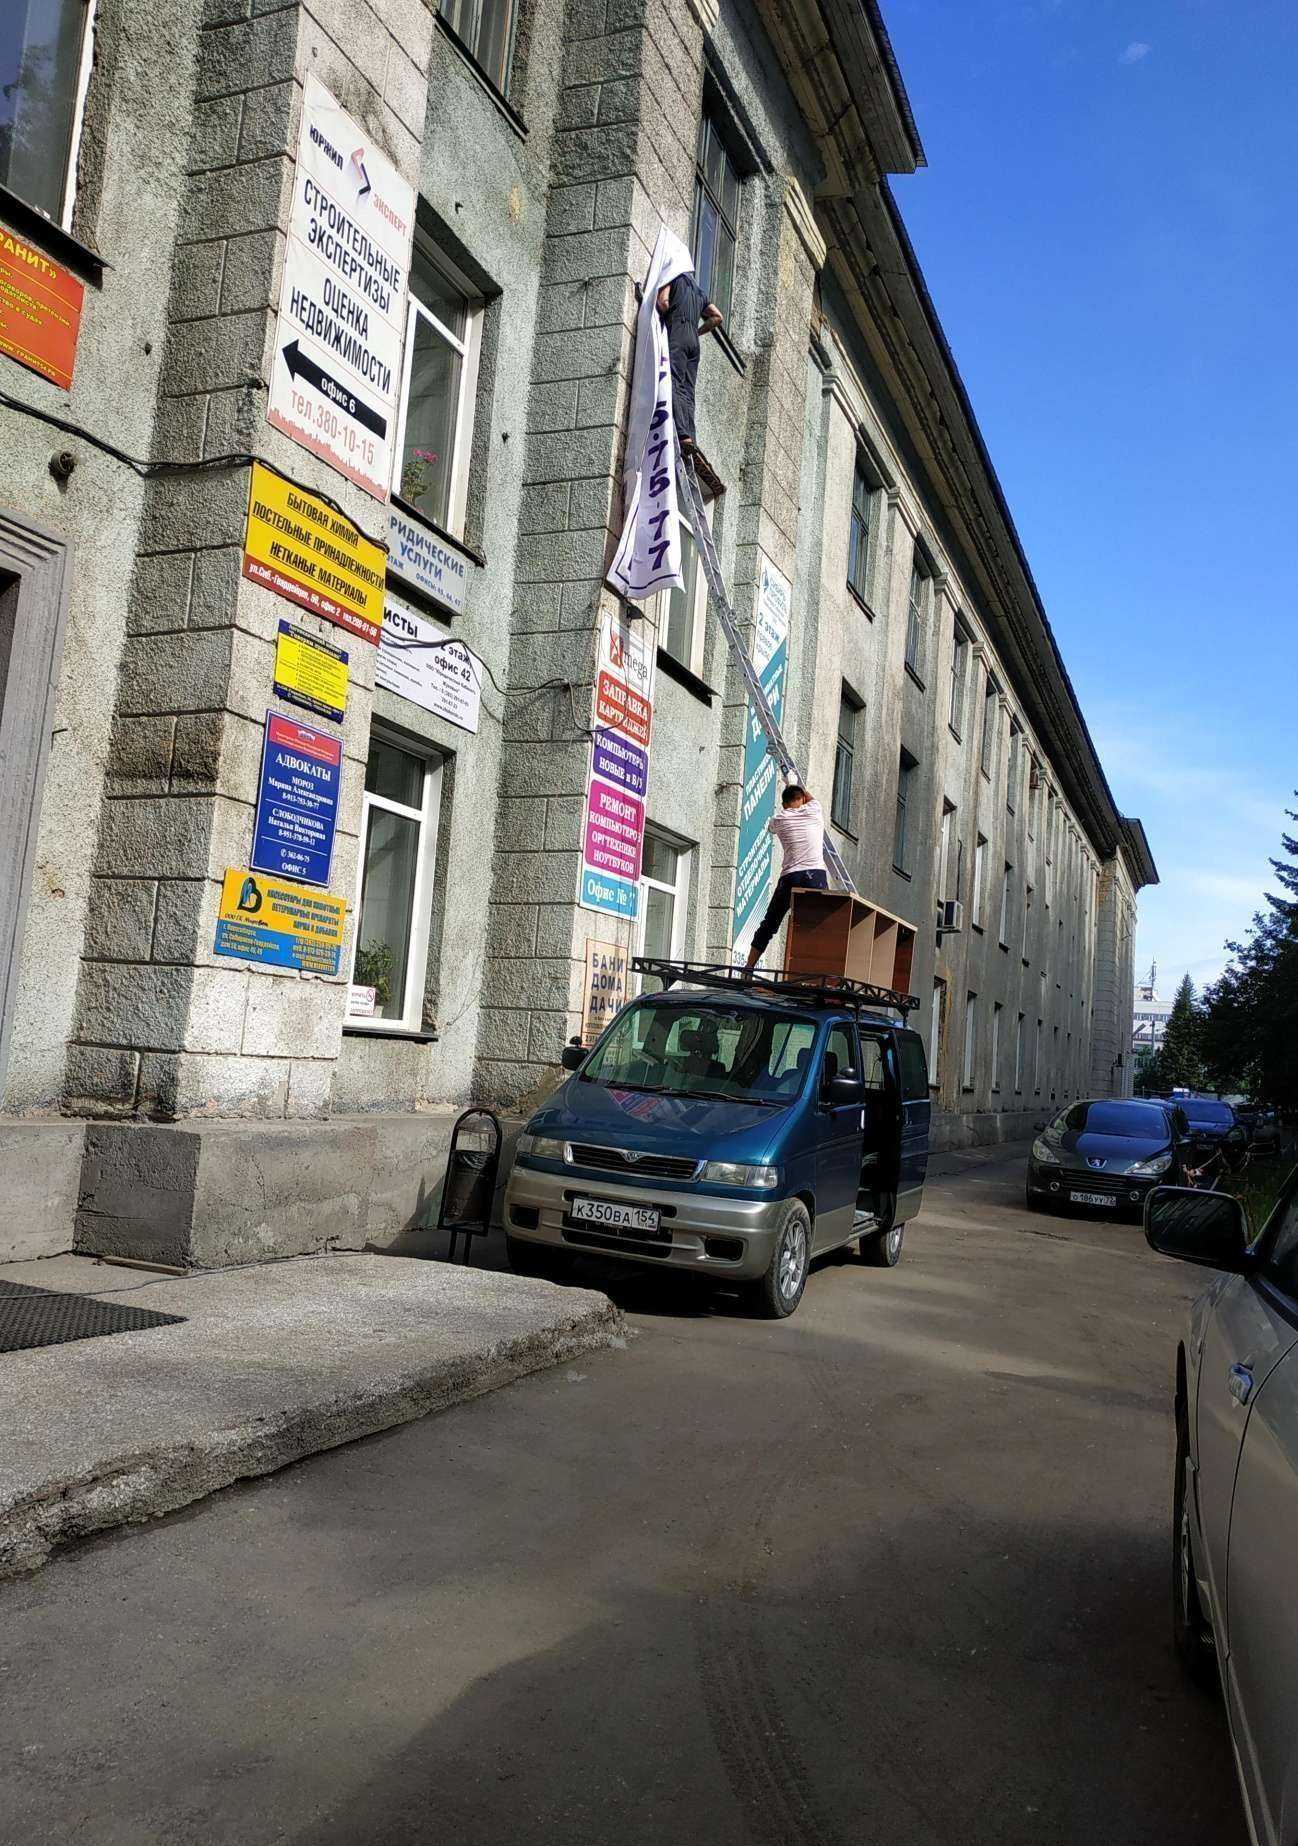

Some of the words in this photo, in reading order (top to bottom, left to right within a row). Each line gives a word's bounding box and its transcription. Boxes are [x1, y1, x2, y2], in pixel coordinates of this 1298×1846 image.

[373, 194, 407, 235] ЭКСПЕРТ
[304, 179, 400, 292] СТРОИТЕЛЬНЫЕ
[308, 218, 391, 314] ЭКСПЕРТИЗЫ
[324, 278, 368, 341] ОЦЕНКА
[290, 286, 391, 394] НЕДВИЖИМОСТИ
[321, 377, 347, 409] офис
[349, 398, 356, 414] 6
[287, 493, 330, 526] БЫТОВАЯ
[330, 520, 359, 547] ХИМИЯ
[253, 501, 312, 546] ПОСТЕЛЬНЫЕ
[313, 537, 385, 591] ПРИНАДЛЕЖНОСТИ
[400, 541, 443, 582] УСЛУГИ
[270, 542, 317, 578] НЕТКАНЫЕ
[318, 568, 368, 607] МАТЕРИАЛЫ
[434, 655, 458, 677] офис
[461, 668, 471, 683] 42
[603, 681, 648, 720] ЗАПРАВКА
[275, 752, 331, 782] АДВОКАТЫ
[292, 776, 315, 791] МОРОЗ
[599, 757, 625, 779] НОВЫЕ
[600, 793, 636, 822] РЕМОНТ
[743, 760, 775, 821] ПАНЕЛИ
[593, 850, 634, 874] НОУТБУКОВ
[587, 878, 615, 905] Офис
[736, 852, 770, 918] МАТЕРИАЛЫ
[592, 953, 624, 973] БАНИ
[591, 973, 622, 992] ДОМА
[590, 996, 624, 1014] ДАЧИ
[576, 1203, 630, 1224] К350ВА
[634, 1210, 655, 1225] 154
